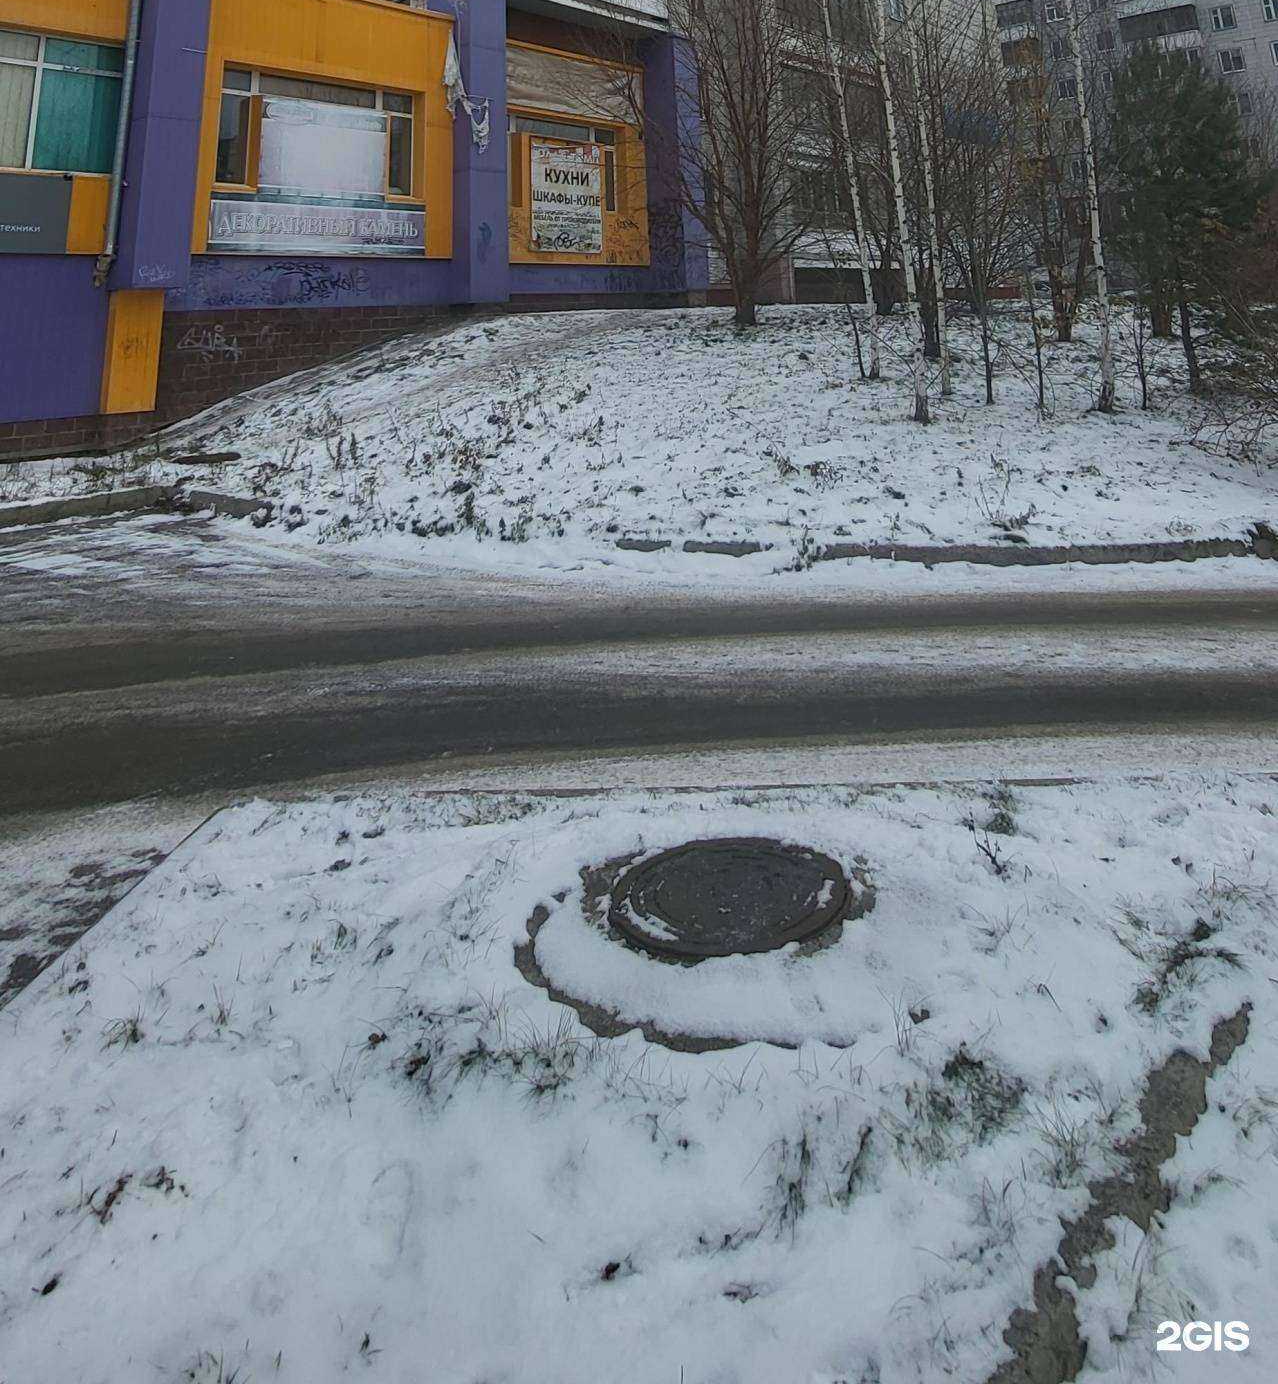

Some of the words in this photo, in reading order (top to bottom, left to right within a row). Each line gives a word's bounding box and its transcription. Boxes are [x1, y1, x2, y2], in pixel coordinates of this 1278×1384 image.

[544, 167, 590, 187] КУХНИ
[532, 190, 601, 207] ШКАФЫ-КУПЕ
[0, 224, 41, 233] техники
[217, 211, 356, 238] ДЕКОРАТИВНЫЙ
[359, 217, 418, 238] КАМЕНЬ
